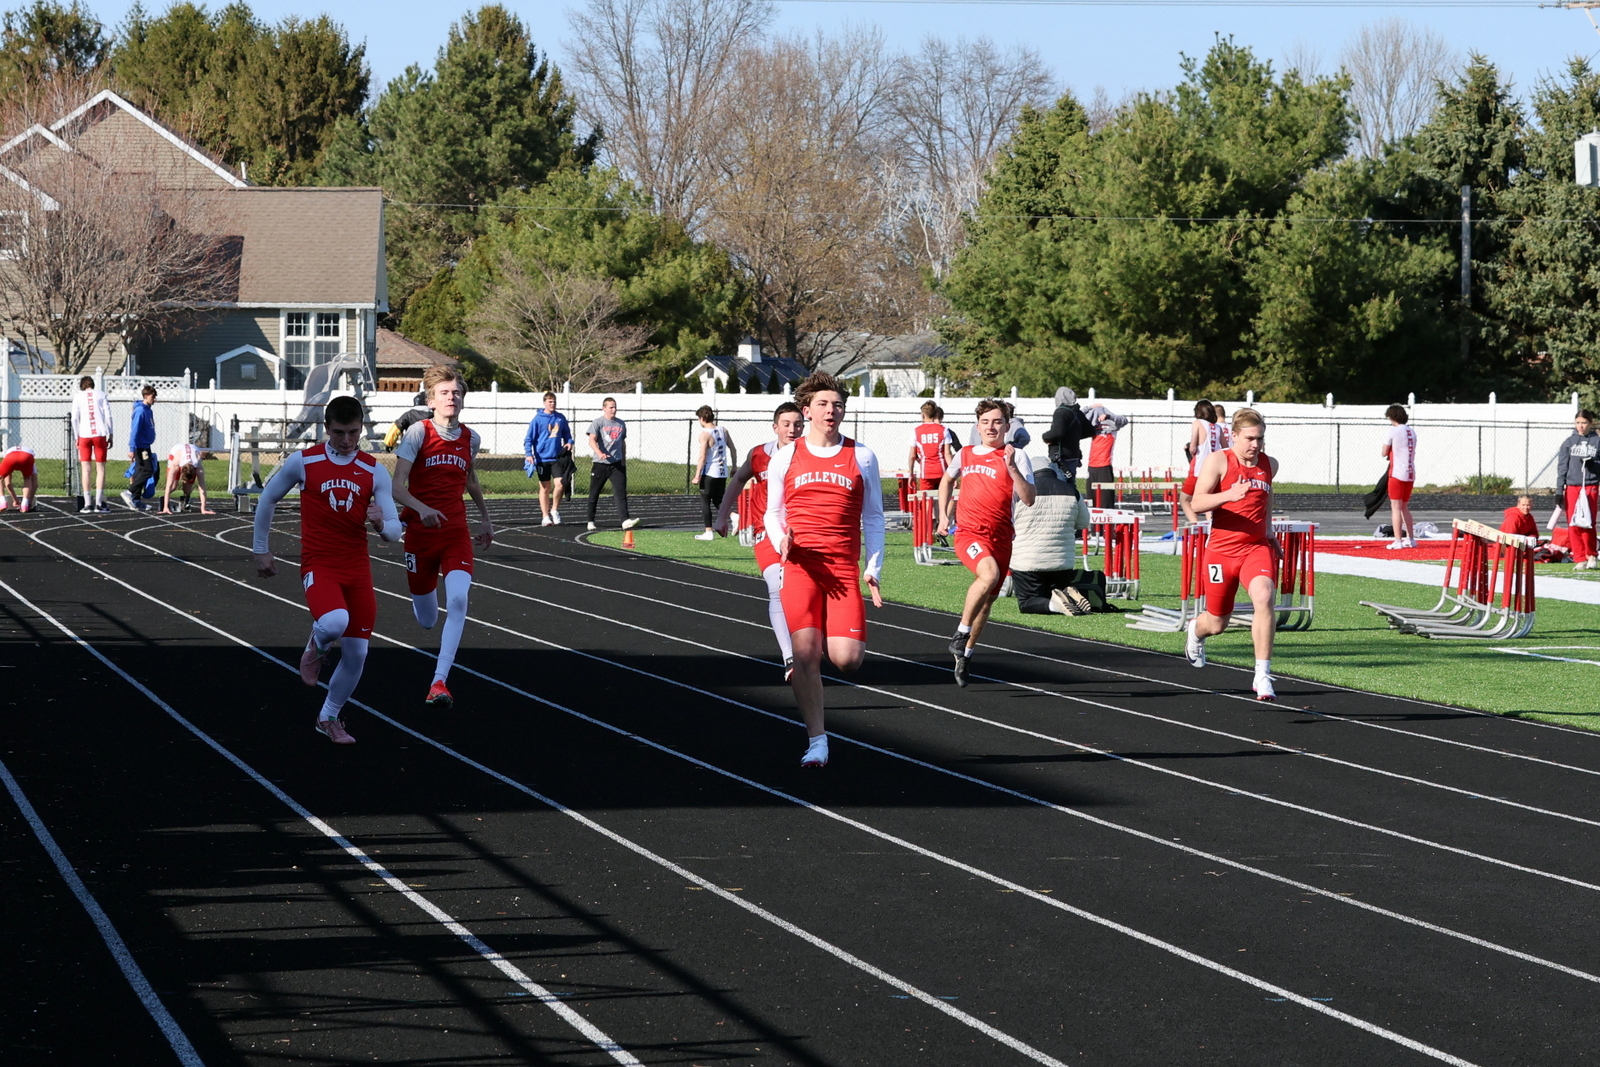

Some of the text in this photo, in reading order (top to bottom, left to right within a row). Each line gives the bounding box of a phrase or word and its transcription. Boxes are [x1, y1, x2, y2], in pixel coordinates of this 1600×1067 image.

[425, 453, 467, 472] BELLEVUE
[320, 478, 362, 497] BELLEVUE
[794, 471, 853, 491] BELLEVUE
[1272, 524, 1293, 532] VUE
[969, 544, 979, 557] 3
[406, 554, 414, 571] 6
[1210, 565, 1220, 582] 2
